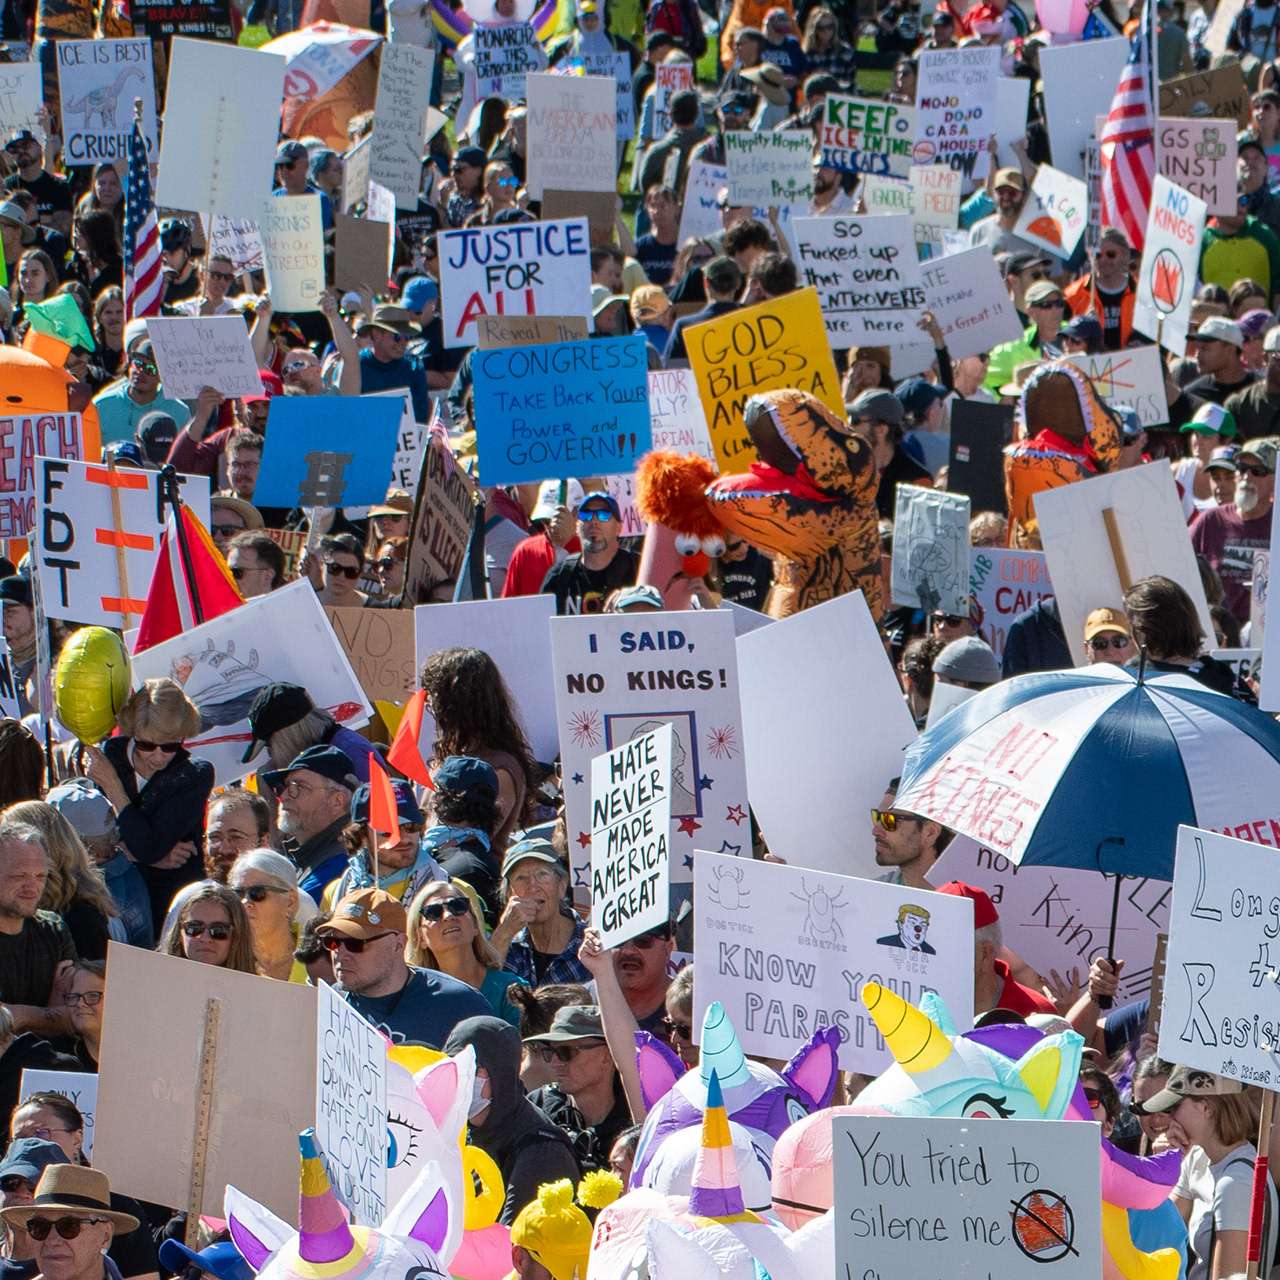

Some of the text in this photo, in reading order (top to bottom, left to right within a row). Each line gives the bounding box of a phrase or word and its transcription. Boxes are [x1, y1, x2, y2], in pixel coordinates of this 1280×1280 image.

[60, 42, 149, 66] ICE IS BEST
[828, 98, 898, 134] KEEP
[920, 96, 958, 111] MOJO
[944, 107, 983, 124] DOJO
[926, 124, 969, 138] CASA
[940, 139, 986, 153] HOUSE
[1168, 187, 1190, 217] NO
[1155, 204, 1196, 247] KINGS
[446, 224, 587, 270] JUSTICE
[486, 261, 543, 294] FOR
[803, 267, 899, 288] that even
[482, 341, 646, 380] CONGRESS:
[702, 314, 785, 366] GOD
[706, 345, 808, 400] BLESS
[505, 433, 638, 466] GOVERN!!
[589, 629, 695, 654] I SAID,
[566, 669, 728, 694] NO KINGS!
[609, 734, 658, 785] HATE
[982, 721, 1059, 782] NO
[592, 770, 664, 828] NEVER
[913, 755, 1040, 848] KINGS
[607, 808, 655, 859] MADE
[592, 834, 669, 904] AMERICA
[601, 873, 660, 934] GREAT
[718, 941, 816, 989] KNOW
[846, 1130, 1040, 1189] You tried to
